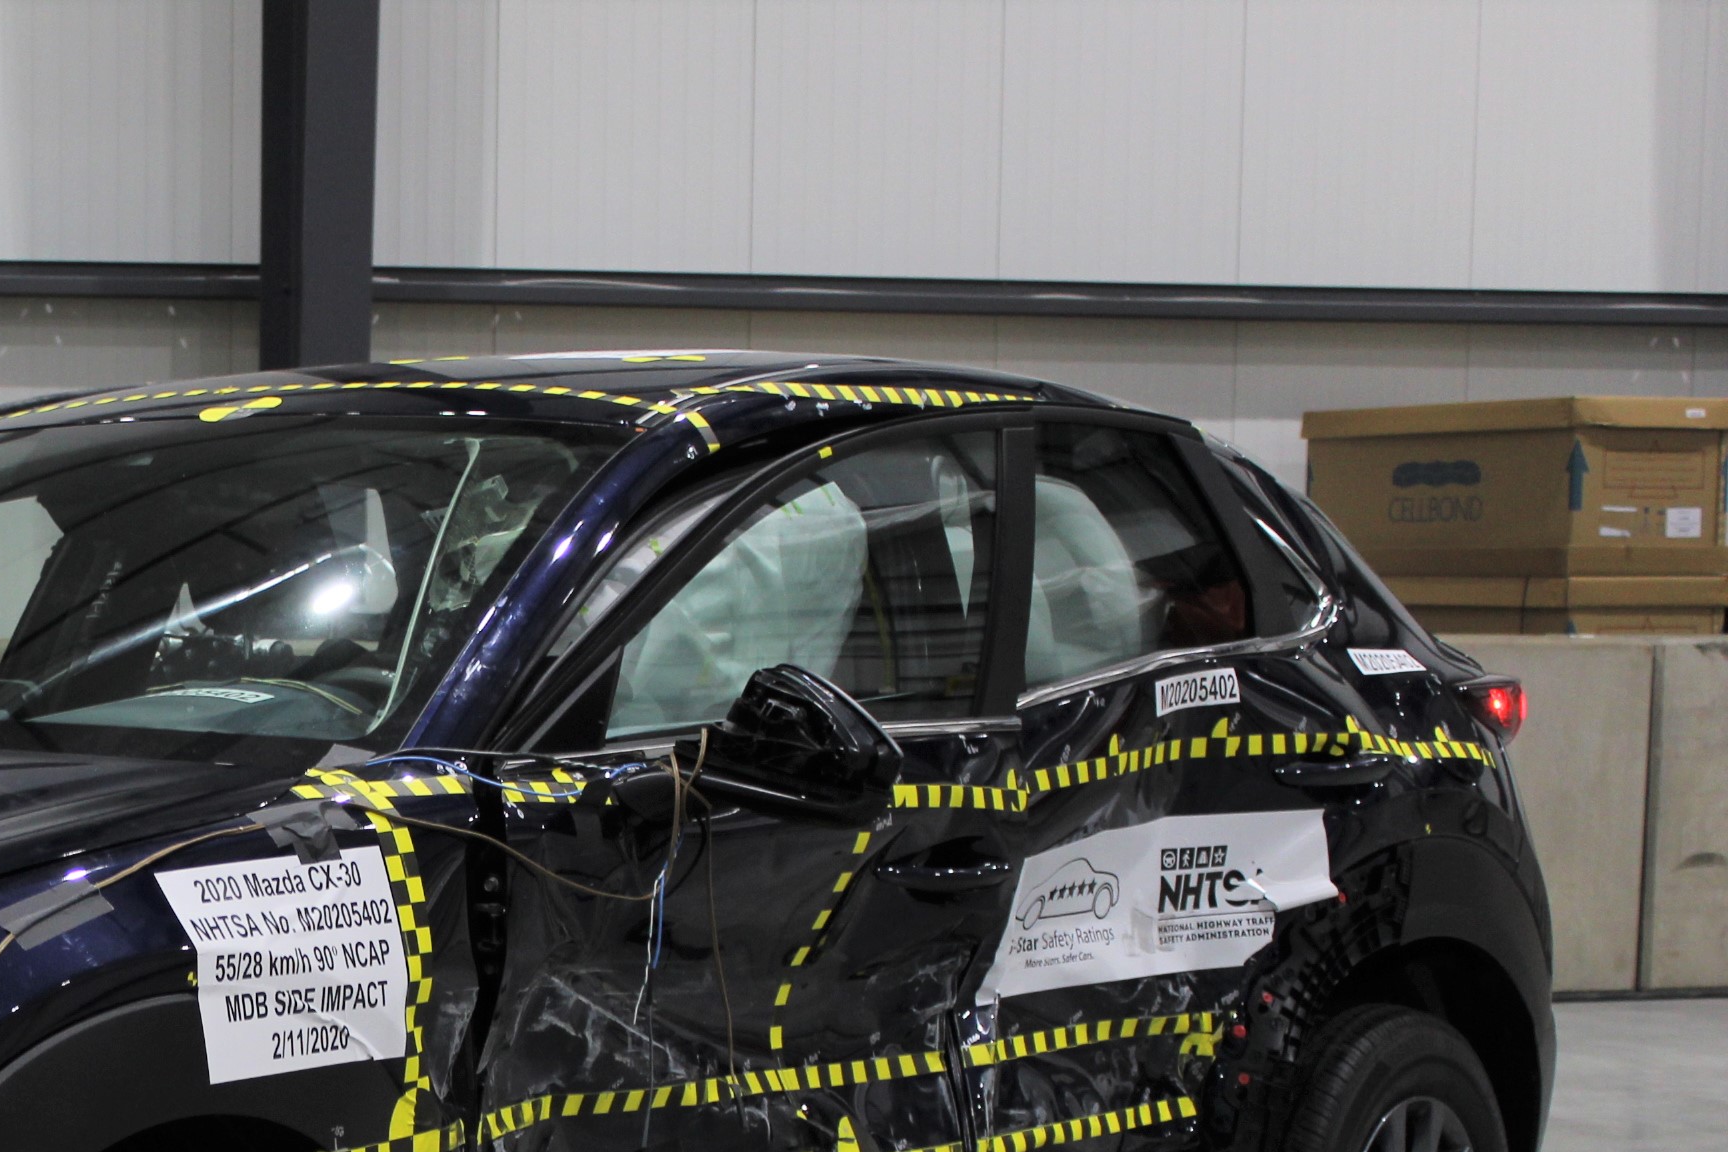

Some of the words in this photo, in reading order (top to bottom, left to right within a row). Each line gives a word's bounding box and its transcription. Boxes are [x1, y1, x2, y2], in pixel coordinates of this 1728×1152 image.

[1387, 496, 1483, 522] CELLBOND
[1161, 674, 1237, 711] M20205402
[193, 876, 242, 903] 2020
[242, 869, 305, 898] Mazda
[307, 861, 362, 891] CX-30
[1158, 869, 1267, 913] NHTS
[189, 913, 263, 942] NHTSA
[263, 911, 296, 935] No.
[296, 898, 392, 932] M20205402
[1041, 929, 1074, 950] Safety
[1075, 926, 1115, 945] Ratings
[1158, 922, 1195, 934] NATIONAL
[1196, 918, 1243, 930] HIGHWAY
[1159, 934, 1183, 945] SAFETY
[1185, 928, 1270, 942] ADMINISTRATION
[215, 951, 263, 983] 55/28
[269, 947, 312, 977] km/h
[342, 939, 390, 969] NCAP
[1025, 959, 1042, 969] More
[225, 991, 268, 1023] MDB
[274, 987, 316, 1016] SIDE
[321, 981, 388, 1013] IMPACT
[272, 1025, 350, 1060] 2/11/2020
